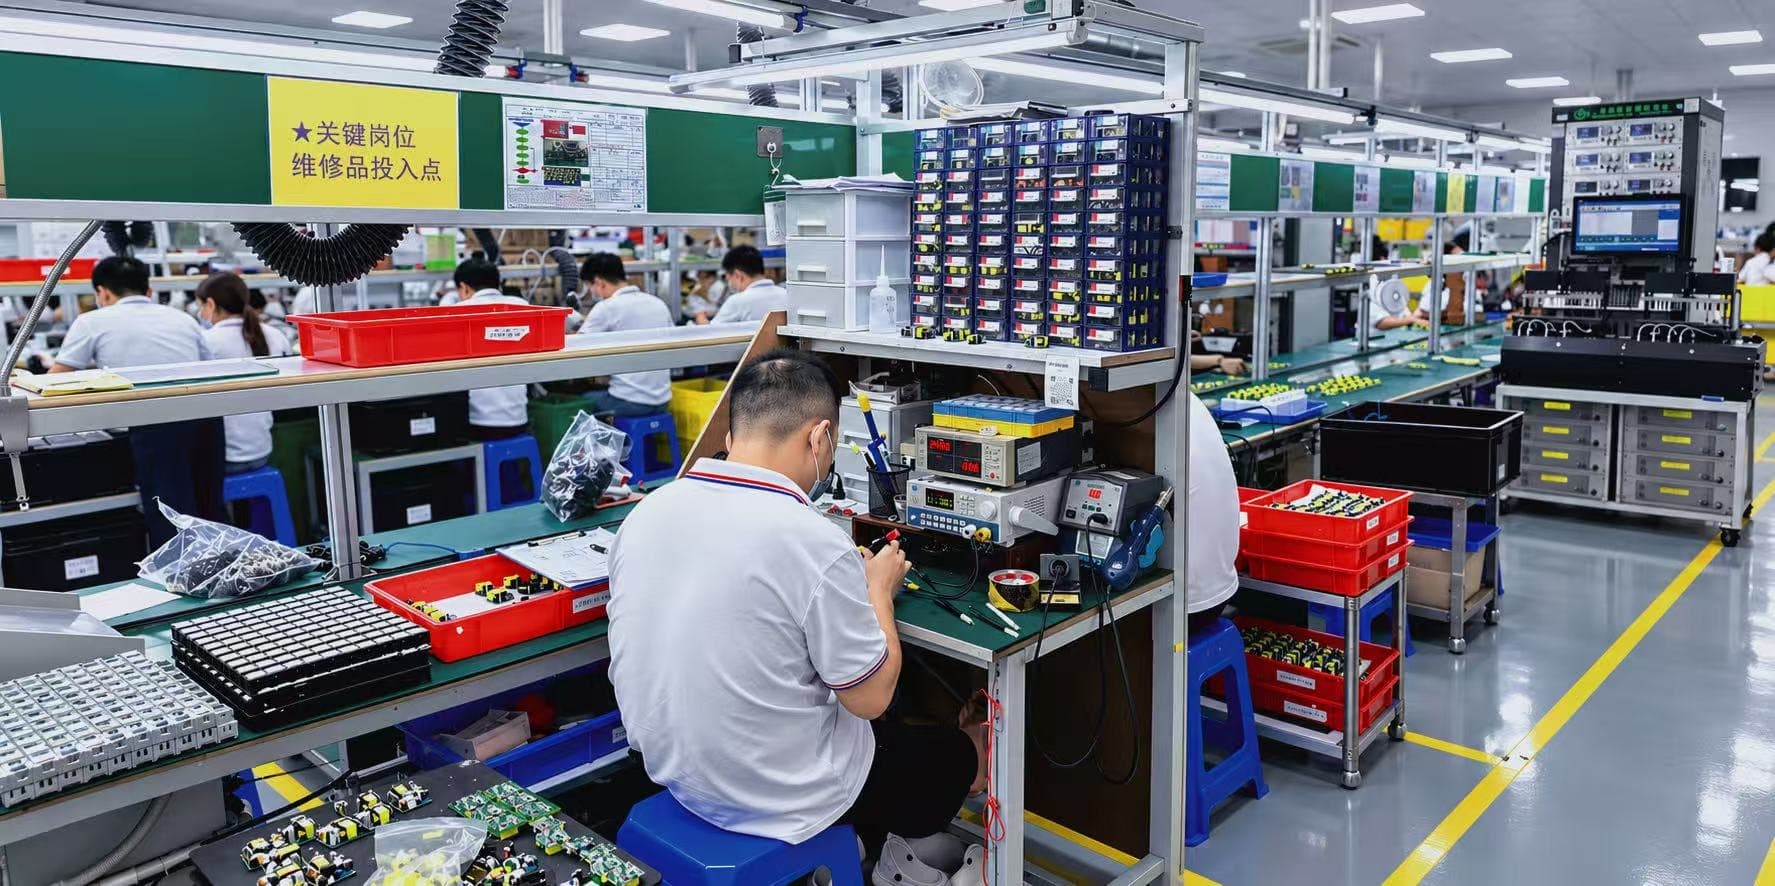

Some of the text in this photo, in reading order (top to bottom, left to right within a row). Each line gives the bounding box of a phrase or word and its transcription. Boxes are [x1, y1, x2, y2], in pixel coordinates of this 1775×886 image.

[316, 120, 416, 149] 关键岗位
[291, 152, 442, 182] 维修品投入点
